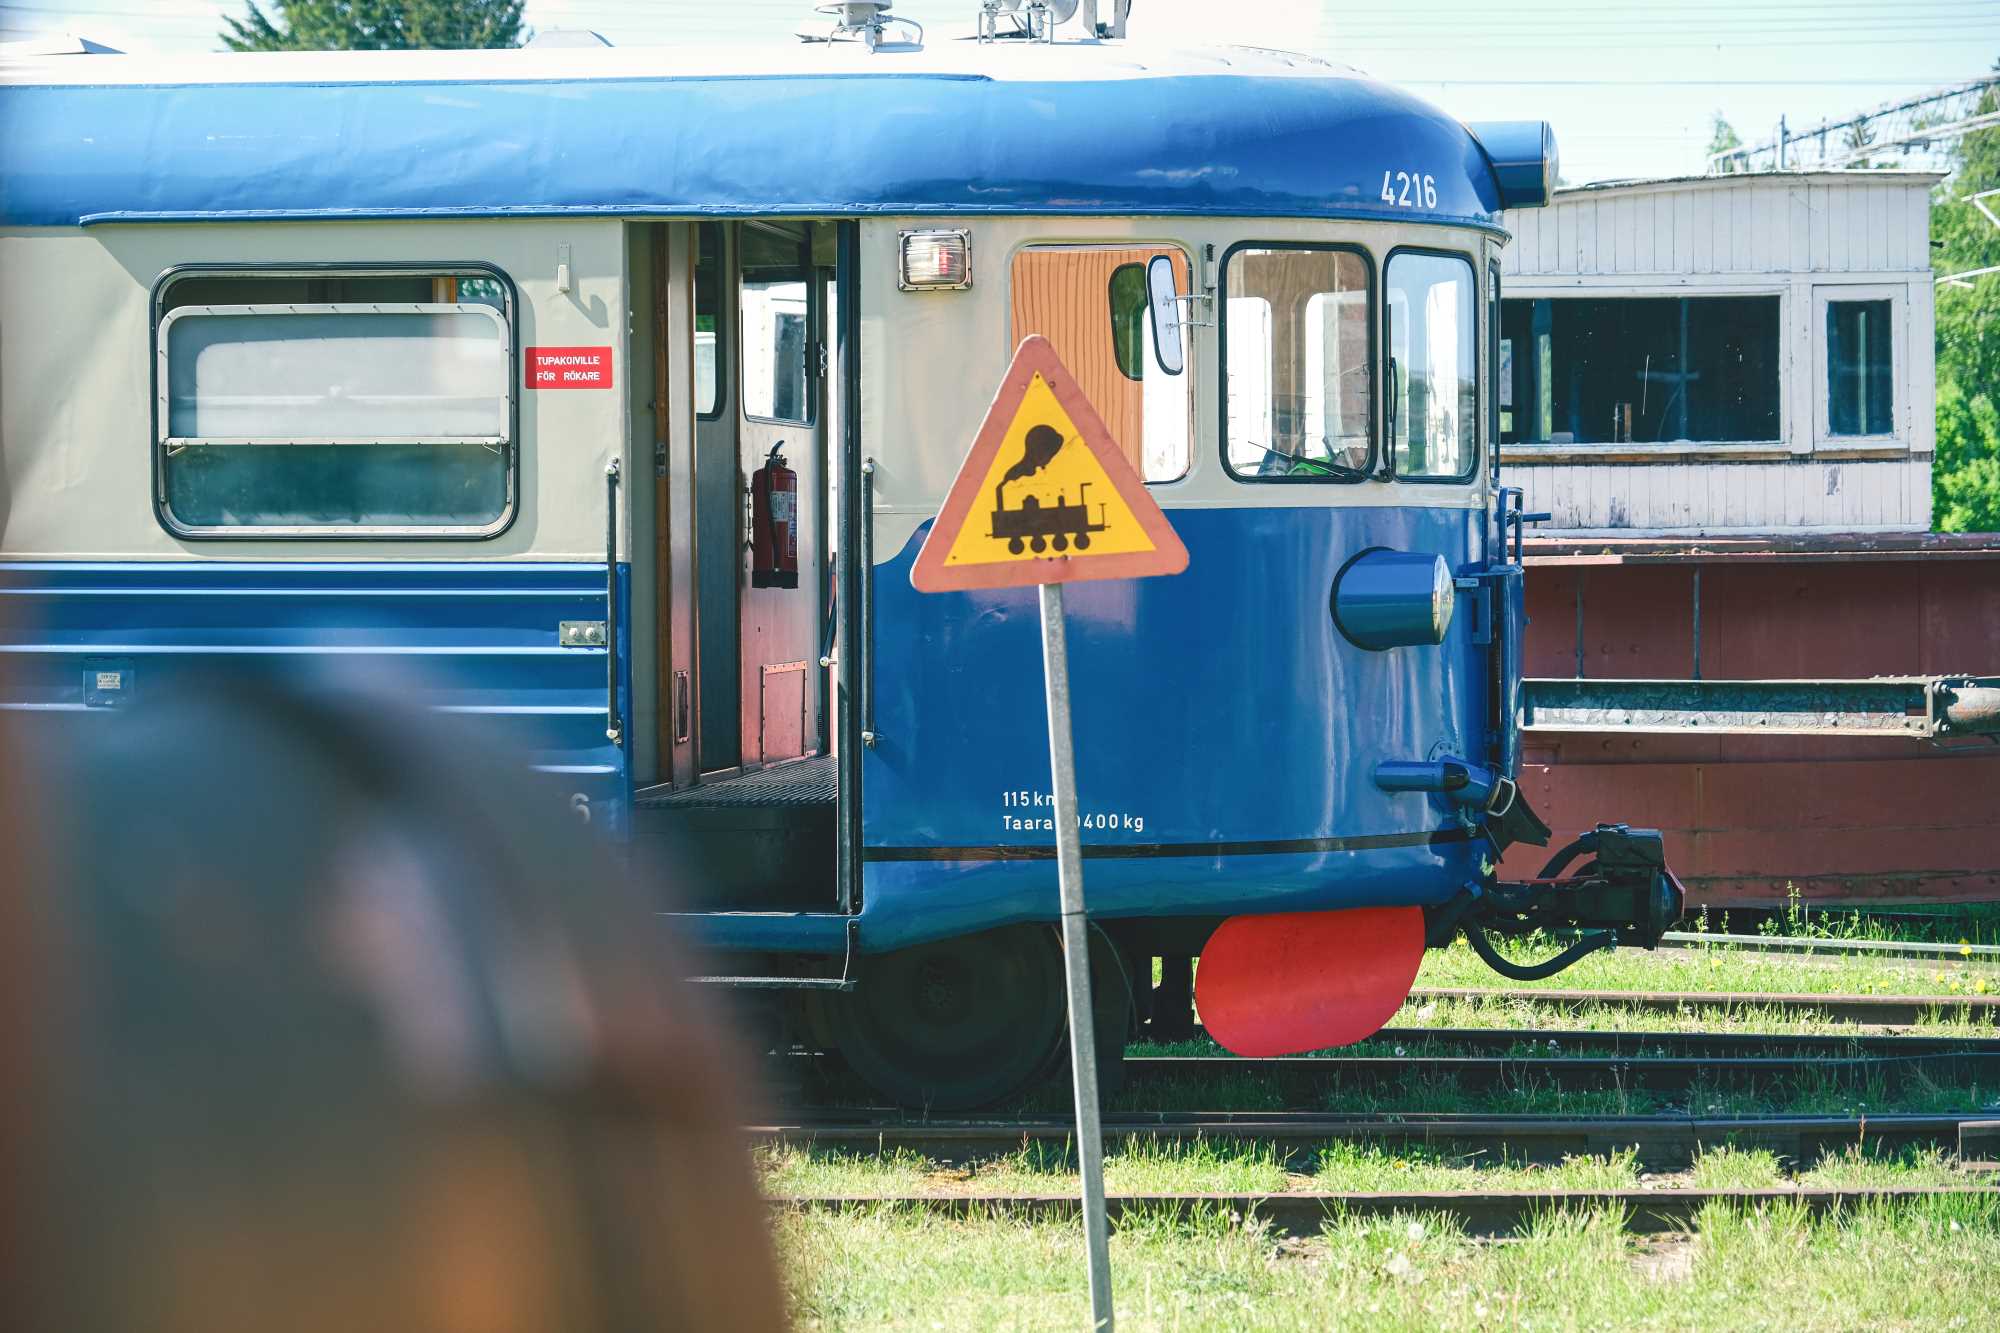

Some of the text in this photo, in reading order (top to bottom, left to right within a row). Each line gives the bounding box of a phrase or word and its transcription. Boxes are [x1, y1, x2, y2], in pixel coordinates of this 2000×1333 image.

[1382, 171, 1437, 208] 4216
[536, 355, 601, 366] TUPAKOIVILLE
[536, 371, 601, 381] FÖR RÖKARE
[1003, 791, 1030, 807] 115
[1003, 815, 1054, 830] Taara
[1123, 813, 1144, 832] kg
